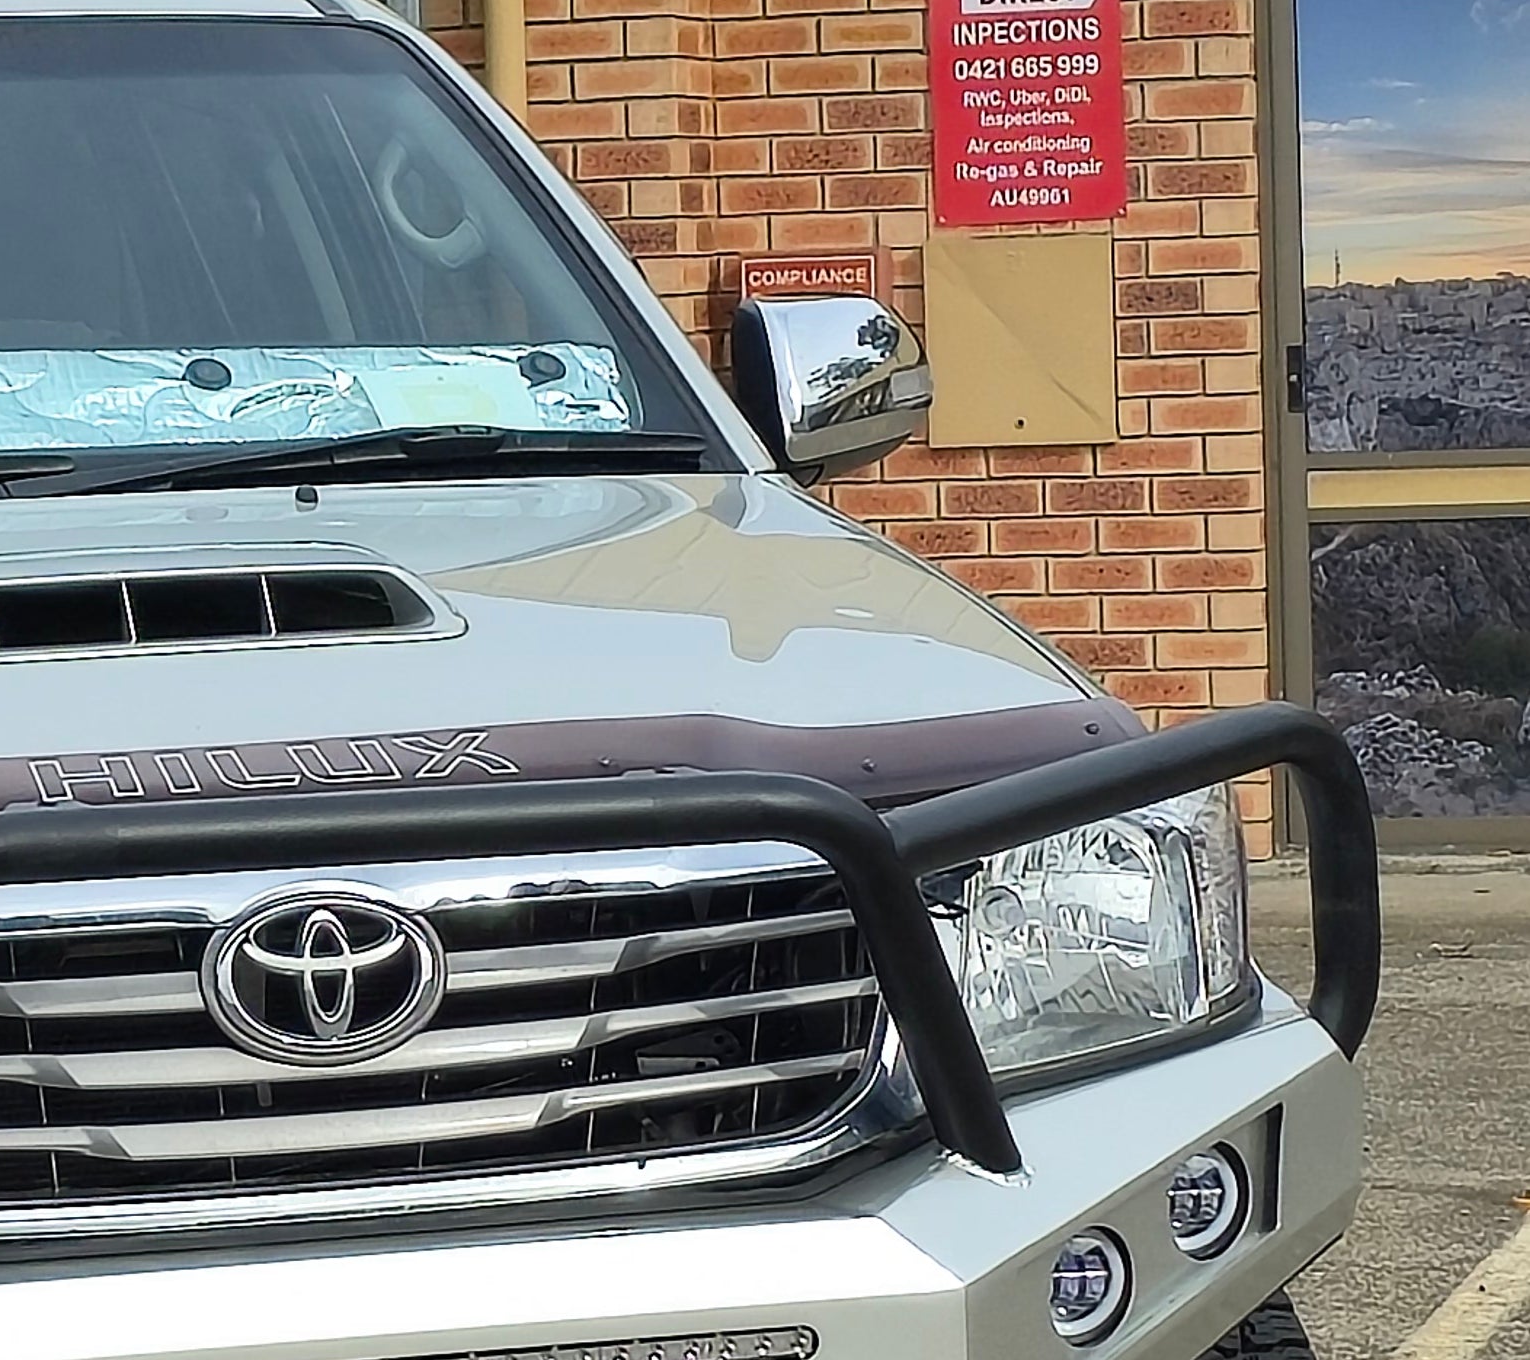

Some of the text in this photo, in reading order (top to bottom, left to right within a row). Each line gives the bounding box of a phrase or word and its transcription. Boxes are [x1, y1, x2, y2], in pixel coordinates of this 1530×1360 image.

[953, 17, 1100, 46] INPECTIONS
[955, 53, 1100, 81] 0421 665 999
[963, 90, 1006, 109] RWC,
[1009, 89, 1050, 106] Uber,
[967, 134, 1090, 154] Air conditioning
[956, 157, 1103, 182] Re-gas & Repair
[748, 266, 867, 287] COMPLIANCE
[29, 731, 519, 802] HILUX
